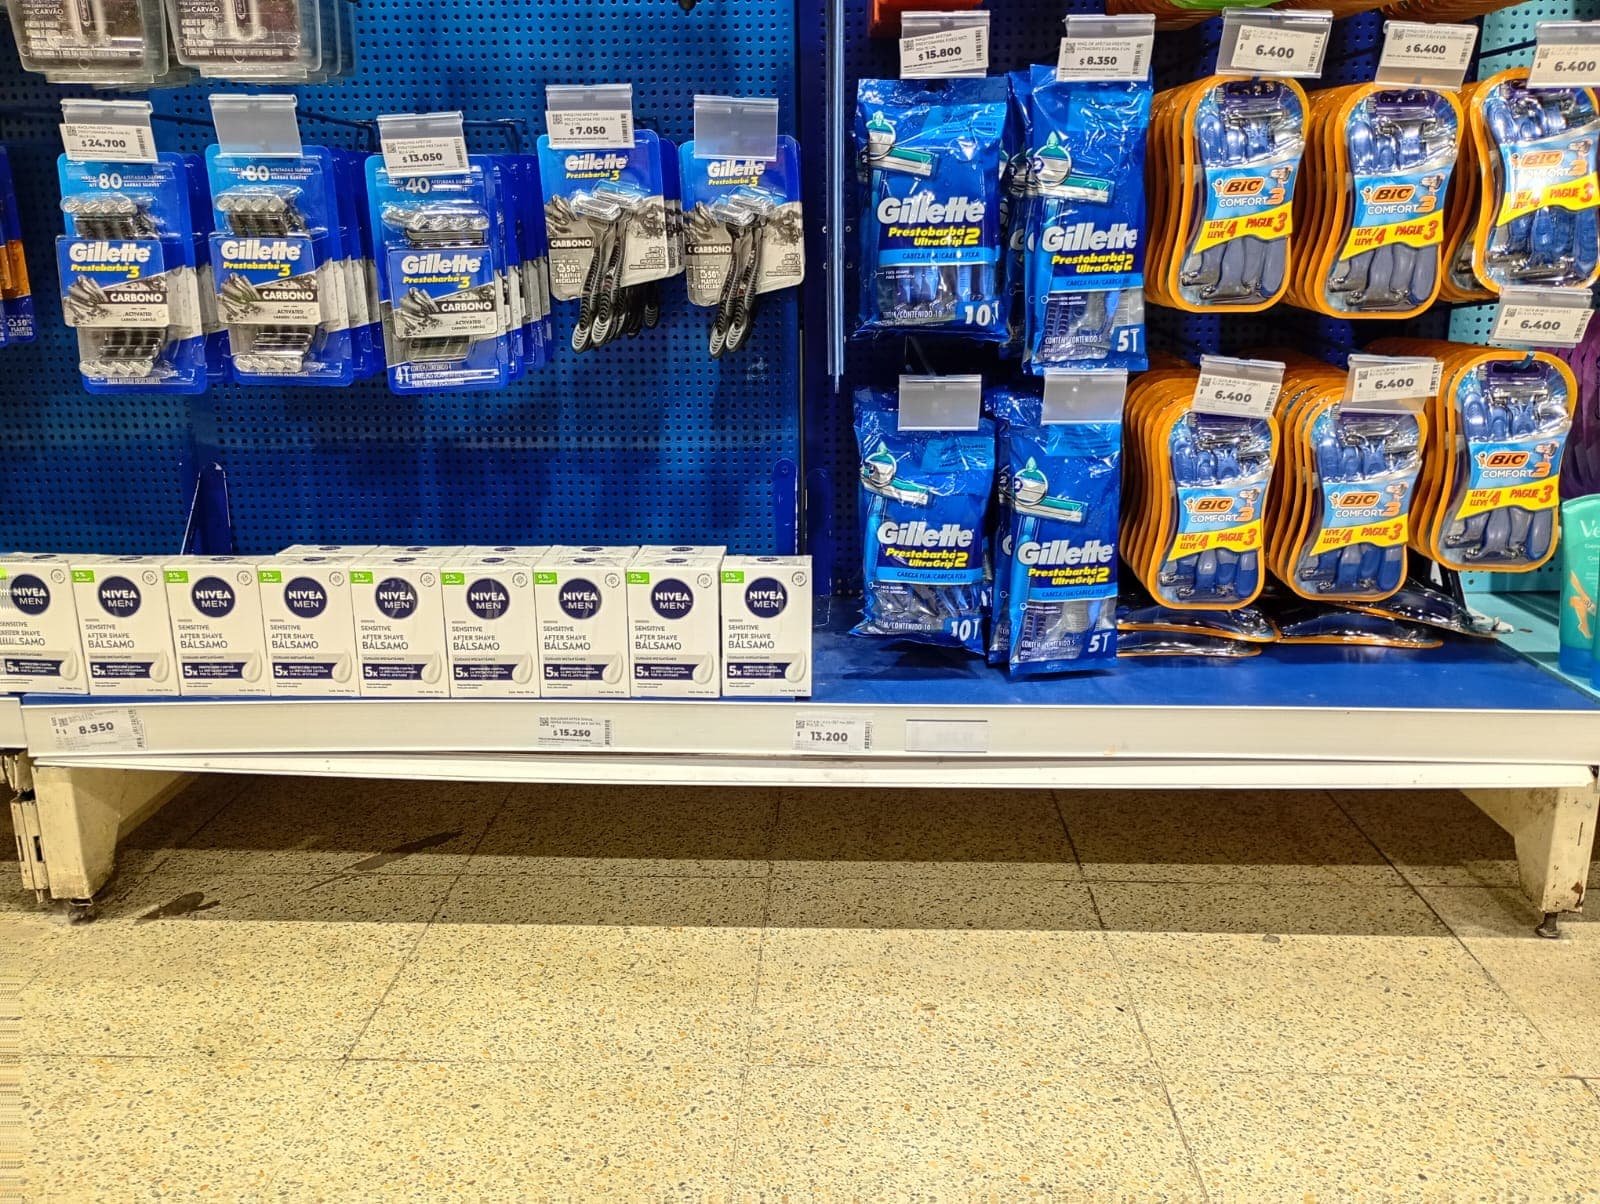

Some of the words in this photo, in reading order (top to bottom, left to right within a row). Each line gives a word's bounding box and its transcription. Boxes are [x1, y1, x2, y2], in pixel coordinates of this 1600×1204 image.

[926, 47, 961, 59] 15.800
[1256, 45, 1294, 59] 6.400
[1414, 44, 1446, 54] 6.400
[1087, 56, 1117, 65] 8.350
[1554, 61, 1596, 72] 6.400
[409, 153, 442, 162] 13.050
[565, 153, 627, 171] Gillette
[246, 165, 270, 181] 80
[707, 160, 764, 176] Gillette
[99, 173, 122, 189] 80
[610, 170, 620, 180] 3
[749, 176, 758, 186] 3
[406, 178, 430, 193] 40
[1219, 196, 1267, 207] COMFORT
[1267, 188, 1284, 205] 3
[1550, 188, 1580, 198] PAGUE
[1580, 183, 1593, 202] 3
[878, 195, 985, 224] Gillette
[1368, 204, 1418, 215] COMFORT
[1417, 196, 1436, 212] 3
[1227, 221, 1237, 237] 4
[1245, 217, 1273, 229] PAGUE
[1274, 212, 1287, 232] 3
[964, 228, 980, 245] 2
[1042, 222, 1137, 252] Gillette
[1375, 228, 1386, 244] 4
[1394, 224, 1424, 237] PAGUE
[1424, 220, 1438, 240] 3
[69, 242, 150, 262] Gillette
[220, 240, 300, 260] Gillette
[402, 254, 481, 274] Gillette
[1124, 254, 1134, 270] 2
[127, 266, 139, 278] 3
[278, 264, 290, 277] 3
[458, 276, 470, 288] 3
[110, 293, 162, 302] CARBONO
[262, 291, 314, 300] CARBONO
[441, 301, 492, 312] CARBONO
[1520, 320, 1560, 331] 6.400
[1375, 378, 1414, 390] 6.400
[1215, 390, 1252, 402] 6.400
[1482, 469, 1532, 478] COMFORT
[1532, 462, 1550, 477] 3
[1490, 491, 1501, 505] 4
[1510, 488, 1539, 499] PAGUE
[1539, 485, 1553, 503] 3
[1191, 514, 1238, 523] COMFORT
[1236, 507, 1254, 521] 3
[1335, 508, 1383, 518] COMFORT
[1382, 502, 1401, 516] 3
[877, 521, 973, 547] Gillette
[1198, 535, 1209, 549] 4
[1217, 533, 1243, 541] PAGUE
[1243, 528, 1257, 545] 3
[1342, 530, 1353, 543] 4
[1361, 527, 1388, 537] PAGUE
[1388, 524, 1402, 540] 3
[1018, 540, 1112, 565] Gillette
[954, 552, 968, 567] 2
[1096, 567, 1110, 582] 2
[14, 588, 47, 596] NIVEA
[102, 590, 137, 599] NIVEA
[196, 591, 231, 599] NIVEA
[288, 591, 323, 600] NIVEA
[379, 592, 413, 600] NIVEA
[471, 592, 505, 600] NIVEA
[563, 592, 597, 600] NIVEA
[655, 592, 690, 600] NIVEA
[749, 591, 784, 599] NIVEA
[384, 601, 410, 609] MEN
[79, 722, 114, 735] 8.950
[810, 731, 848, 741] 13.200
